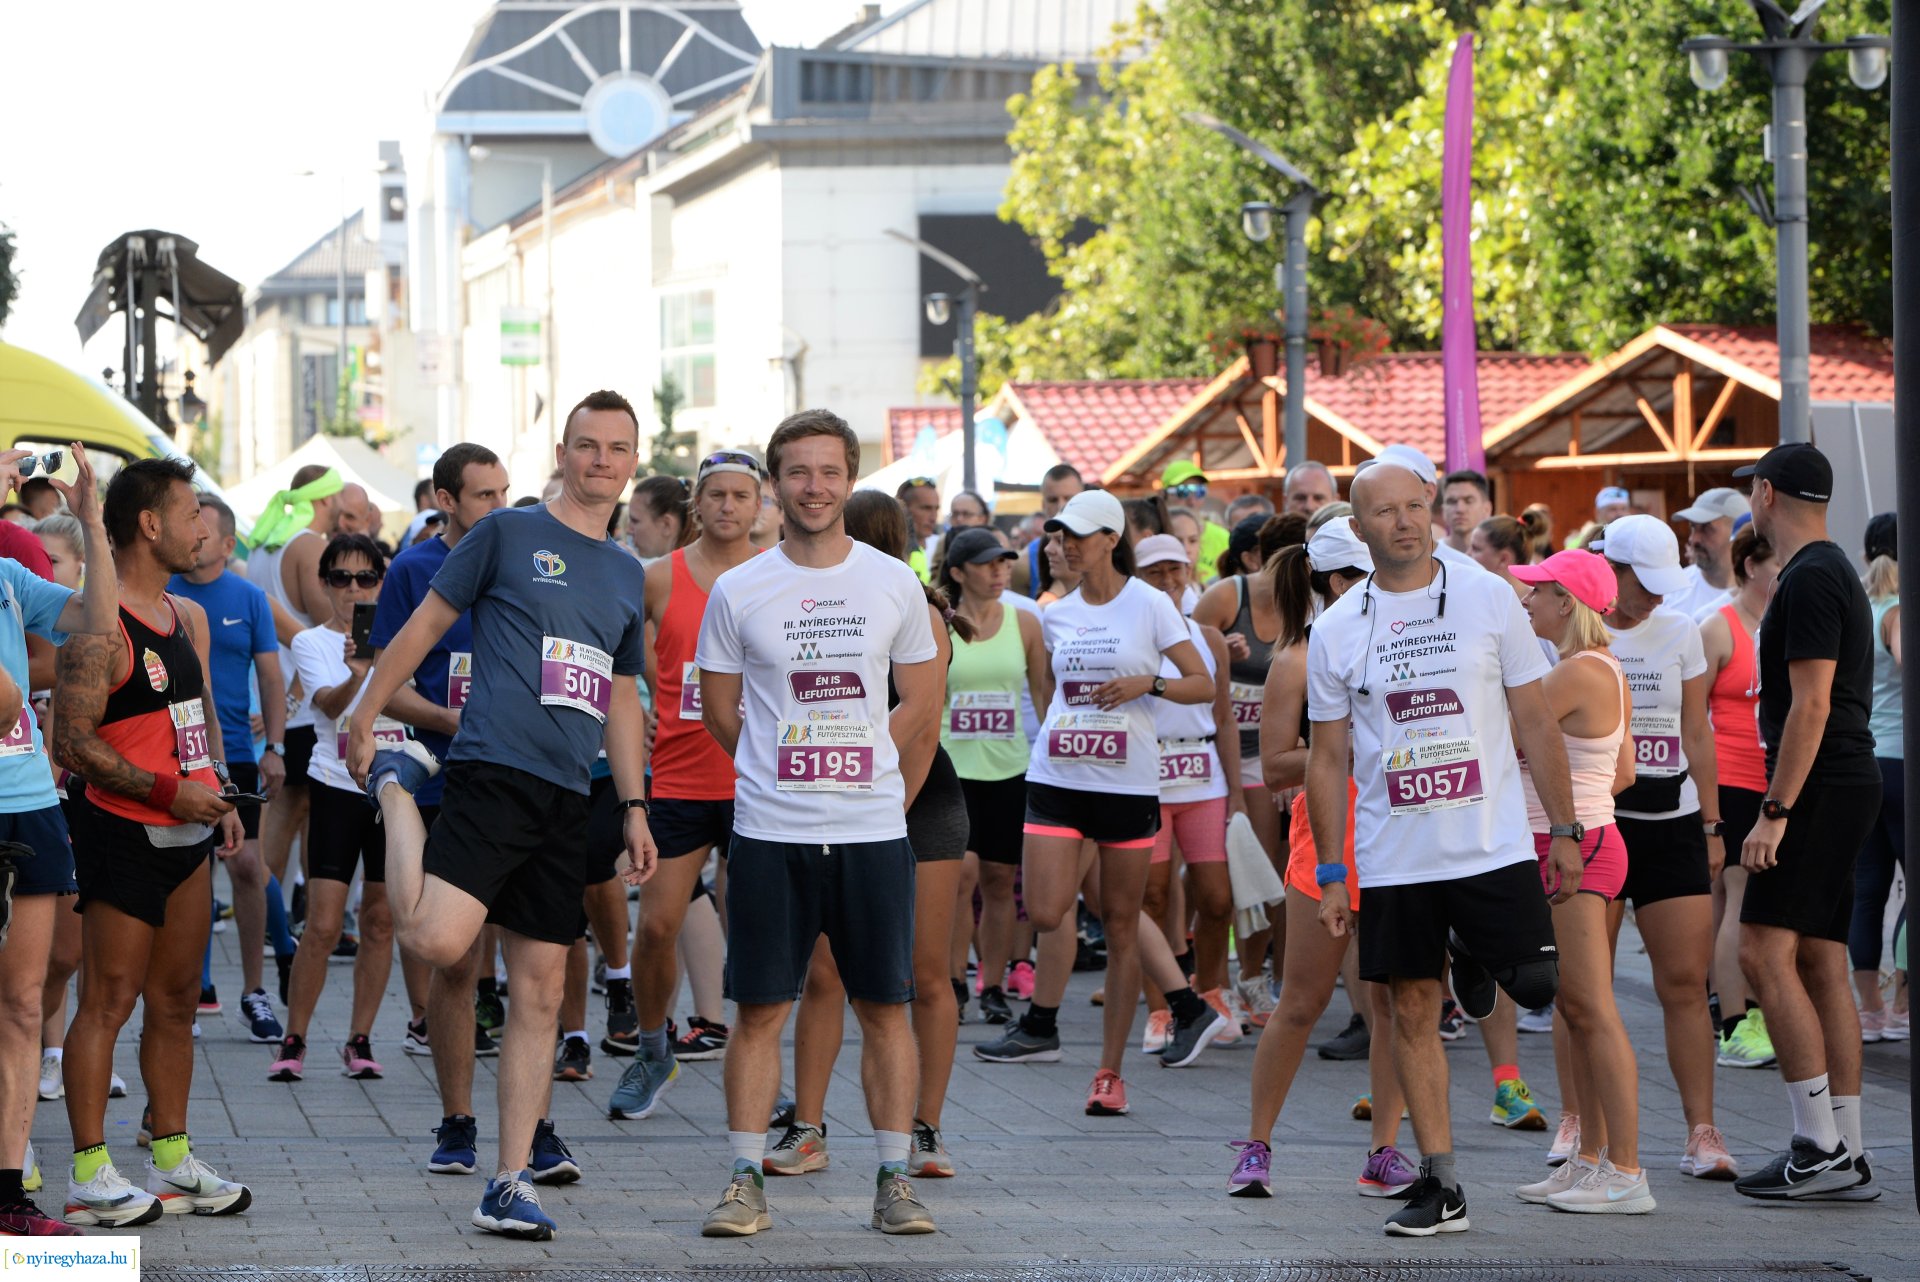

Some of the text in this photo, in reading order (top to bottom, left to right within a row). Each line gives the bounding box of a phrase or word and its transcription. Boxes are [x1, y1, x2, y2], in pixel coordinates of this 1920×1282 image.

[783, 615, 866, 629] III. NYÍREGYHÁZI
[1405, 617, 1435, 628] MOZAIK
[786, 627, 864, 641] FUTÓFESZTIVÁL
[1376, 632, 1456, 654] III. NYÍREGYHÁZI
[1060, 646, 1117, 655] FUTÓFESZTIVÁL
[1380, 643, 1456, 664] FUTÓFESZTIVÁL
[564, 667, 600, 702] 501
[815, 675, 841, 686] ÉN IS
[799, 686, 861, 700] LEFUTOTTAM
[1080, 683, 1091, 693] ÉN
[1411, 693, 1436, 705] ÉN IS
[1396, 702, 1458, 720] LEFUTOTTAM
[958, 711, 1009, 730] 5112
[817, 730, 867, 739] FUTÓFESZTIVÁL
[1058, 733, 1118, 755] 5076
[1633, 739, 1669, 762] 80
[1420, 746, 1471, 760] FUTÓFESZTIVÁL
[789, 751, 861, 777] 5195
[1398, 766, 1468, 801] 5057
